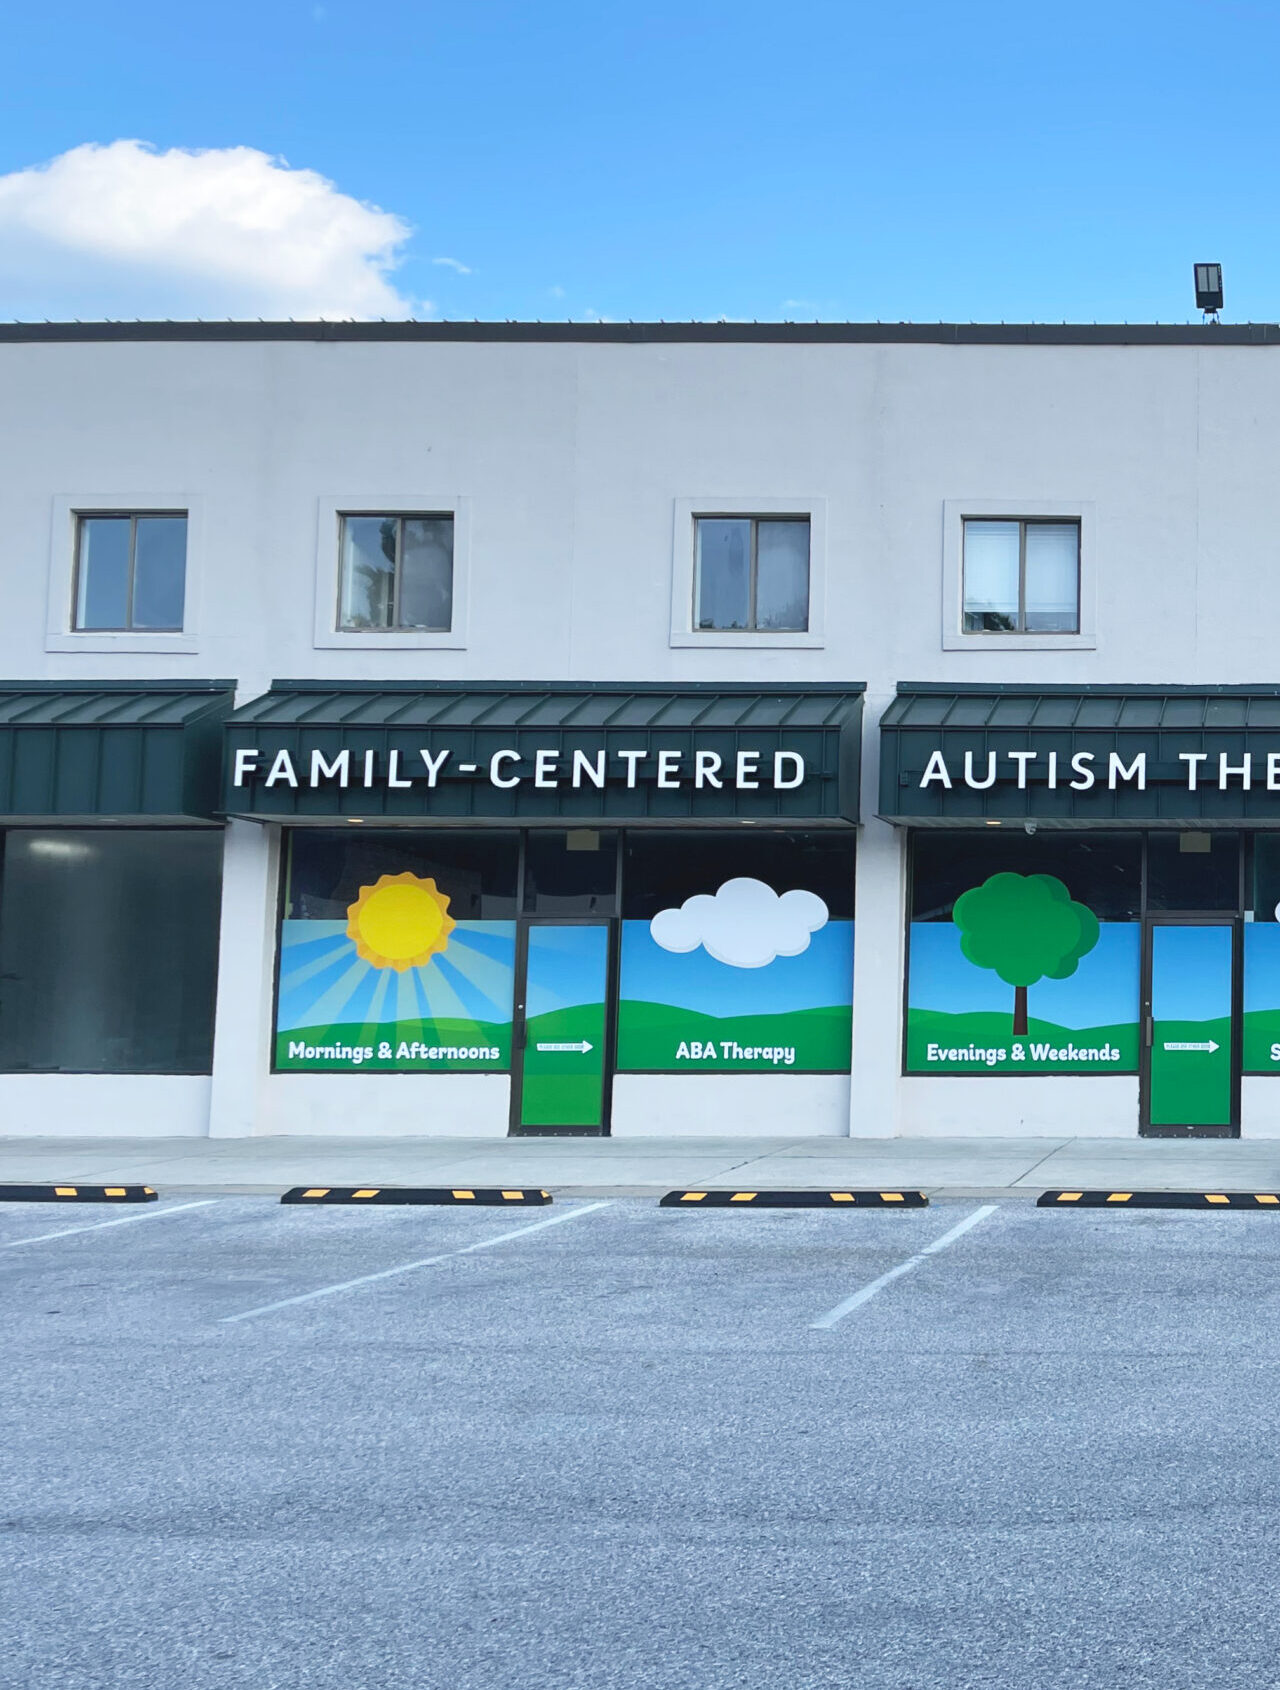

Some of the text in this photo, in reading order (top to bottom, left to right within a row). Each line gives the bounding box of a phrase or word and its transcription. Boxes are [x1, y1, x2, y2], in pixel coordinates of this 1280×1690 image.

[234, 749, 805, 789] FAMILY-CENTERED
[919, 750, 1146, 790] AUTISM
[288, 1041, 500, 1065] Mornings & Afternoons
[675, 1042, 796, 1065] ABA Therapy
[926, 1043, 1121, 1066] Evenings & Weekends
